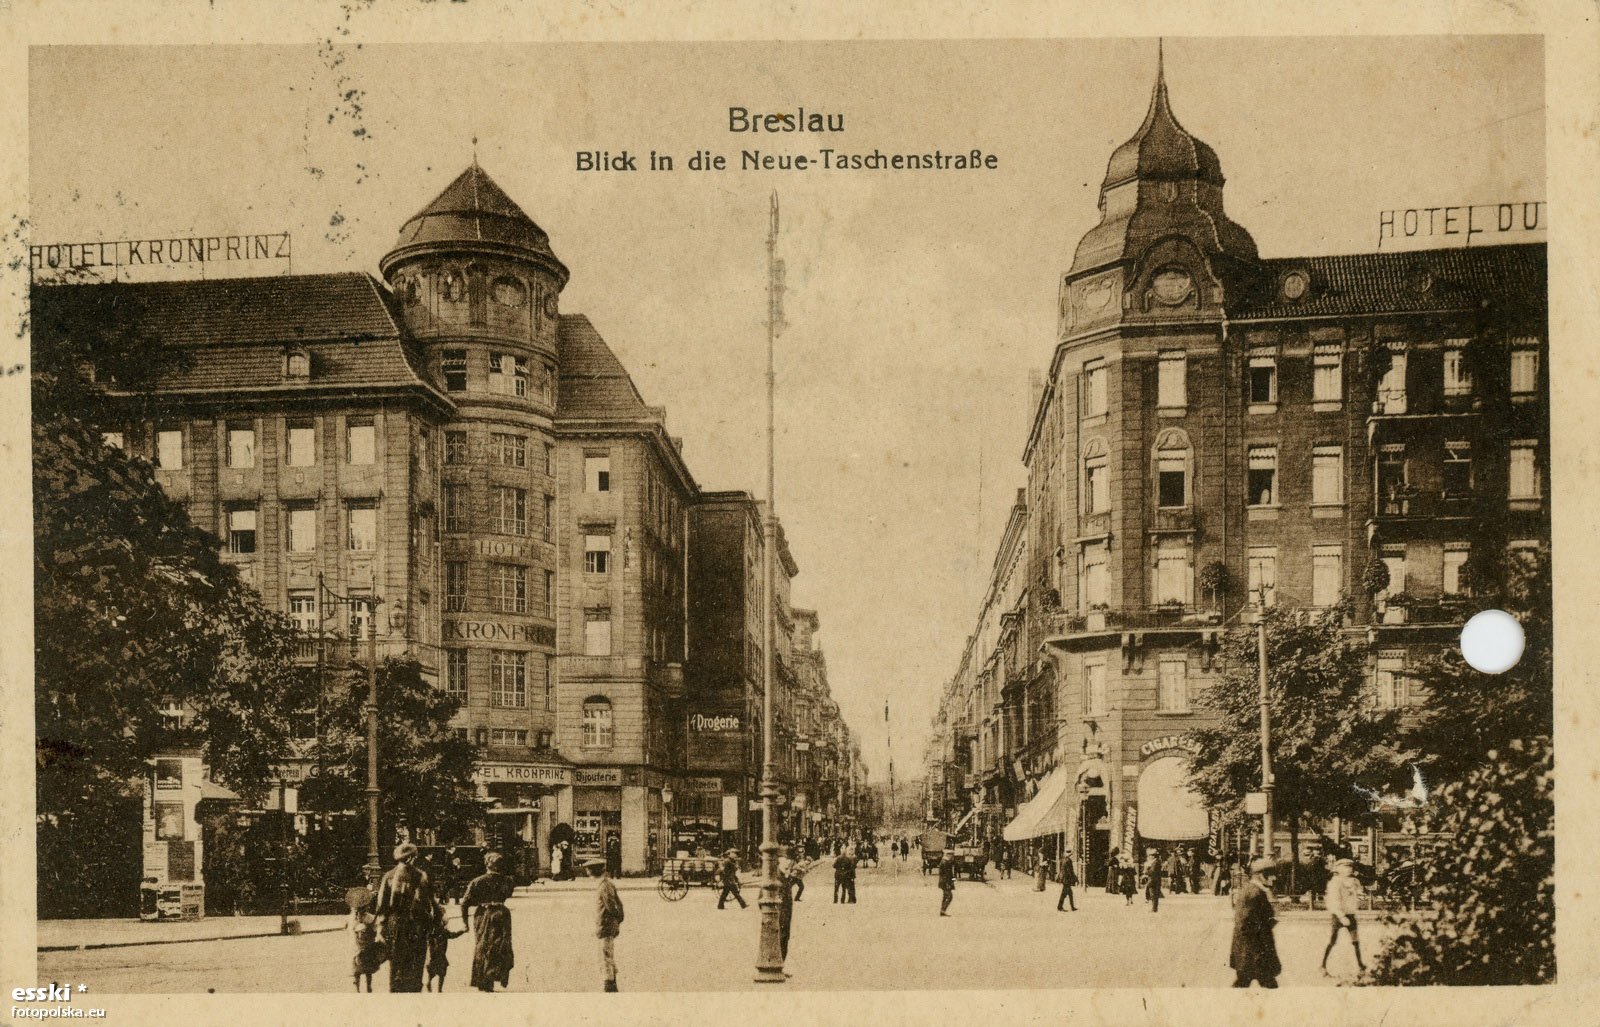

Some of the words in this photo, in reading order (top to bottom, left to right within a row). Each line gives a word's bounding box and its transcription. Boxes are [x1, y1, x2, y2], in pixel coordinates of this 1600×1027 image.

[1379, 206, 1483, 237] HOTEL
[1499, 202, 1539, 231] DU
[30, 242, 113, 268] HOTEL
[128, 233, 291, 265] KRONPRINZ
[691, 714, 740, 731] Drogerie
[506, 767, 565, 780] KRONPRINZ
[575, 771, 617, 784] Bijouterie
